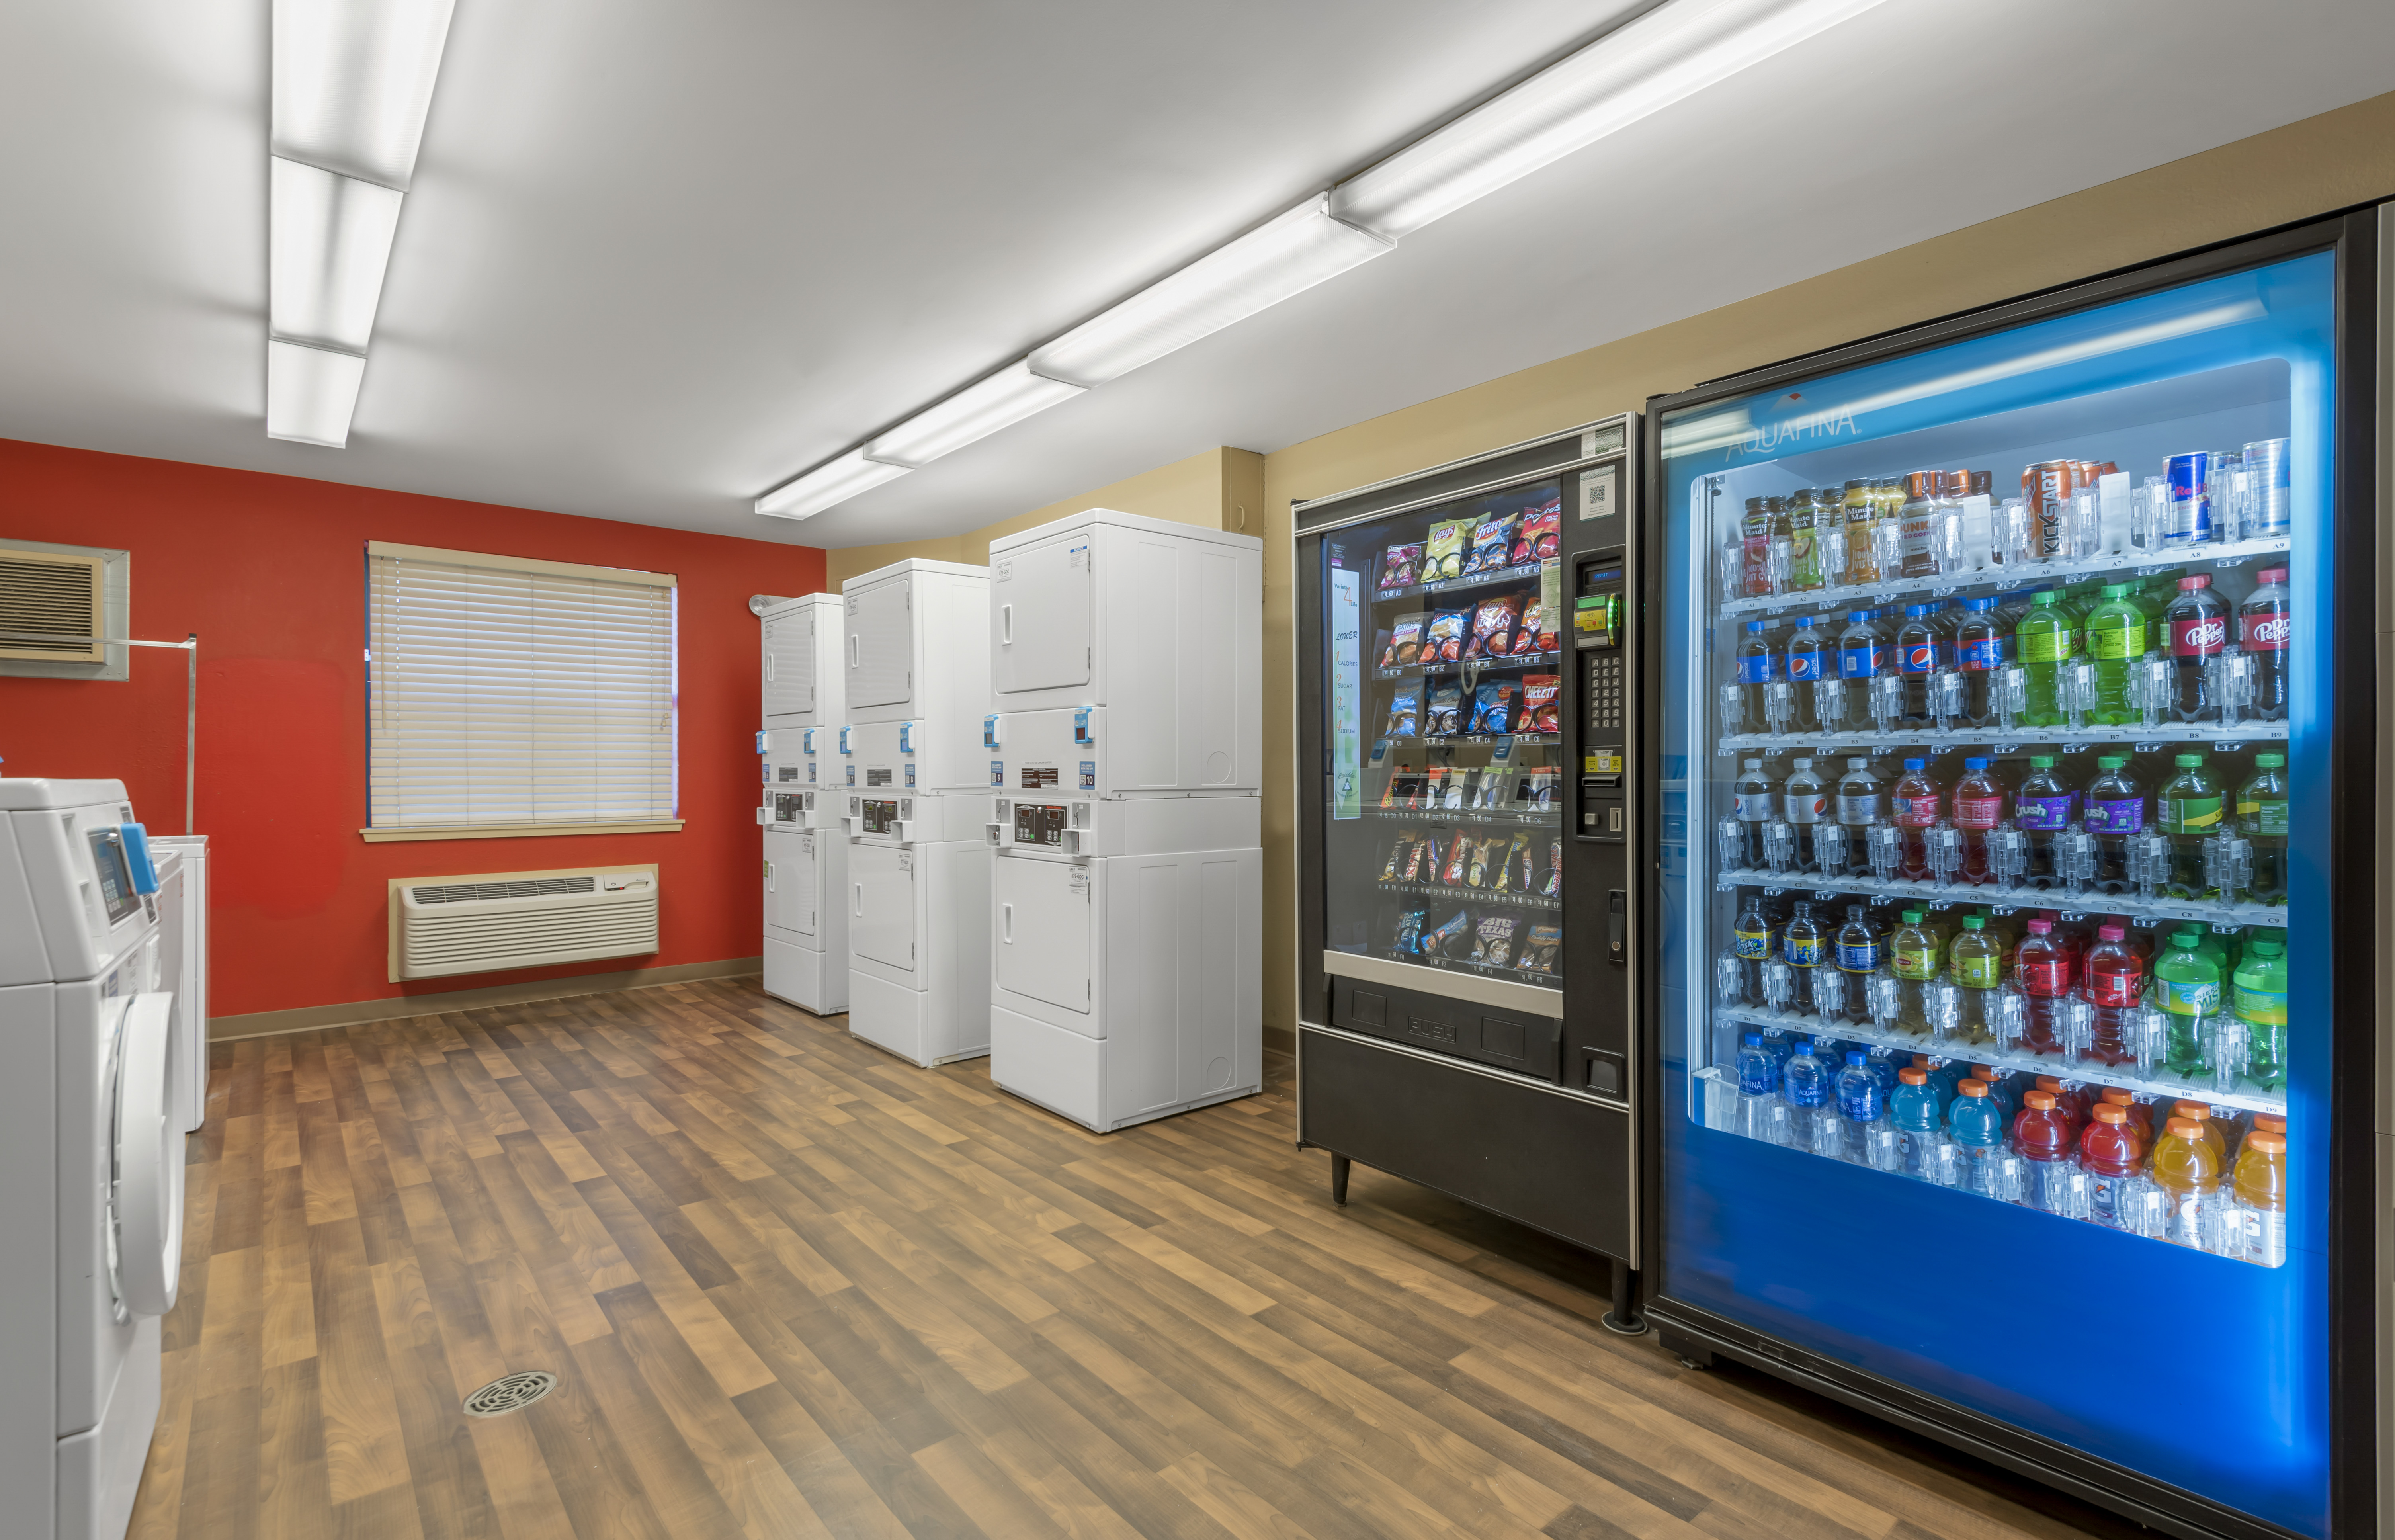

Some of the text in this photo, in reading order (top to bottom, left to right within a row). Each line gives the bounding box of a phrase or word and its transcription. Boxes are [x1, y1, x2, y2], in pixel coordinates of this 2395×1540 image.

[1725, 404, 1856, 462] AQUAFINA
[2176, 484, 2201, 496] Red
[1434, 525, 1455, 541] Lay's
[1476, 518, 1505, 540] Fritos
[1344, 587, 1352, 606] 4
[1397, 623, 1416, 631] SKINS
[2203, 623, 2217, 633] Dr
[1336, 631, 1358, 641] LOWER
[2192, 626, 2223, 646] Pepper
[1336, 651, 1340, 661] 1
[1336, 674, 1342, 684] 2
[1336, 696, 1342, 707] 3
[1336, 719, 1342, 729] 4
[2016, 803, 2046, 817] Crush
[1453, 917, 1465, 926] Donuts
[1483, 917, 1512, 928] BIG
[1479, 926, 1512, 937] TEXAS
[1737, 940, 1754, 950] Brisk
[2196, 990, 2218, 1012] MIS
[1410, 1021, 1454, 1042] PUSH
